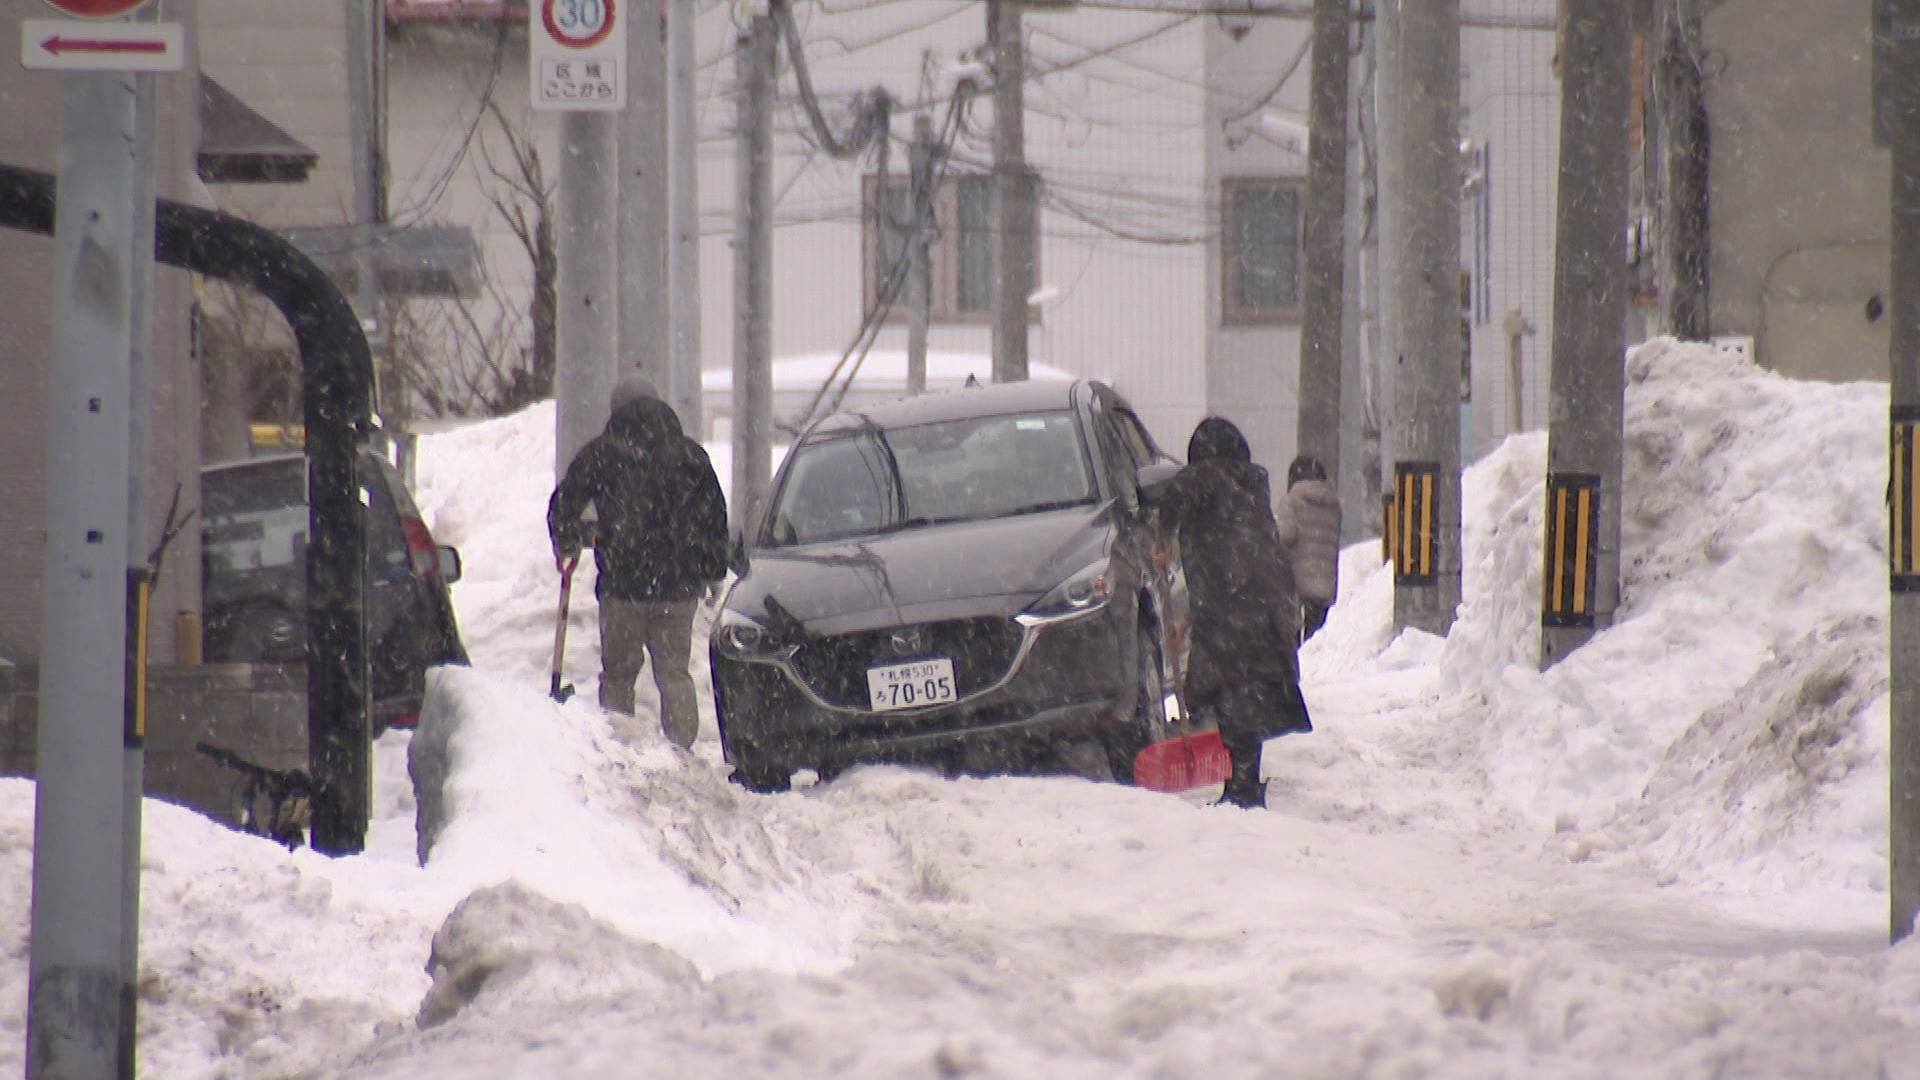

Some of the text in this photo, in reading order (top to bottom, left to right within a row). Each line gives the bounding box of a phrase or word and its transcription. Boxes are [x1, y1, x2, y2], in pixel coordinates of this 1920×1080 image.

[560, 0, 599, 28] 30
[545, 81, 612, 98] ここから
